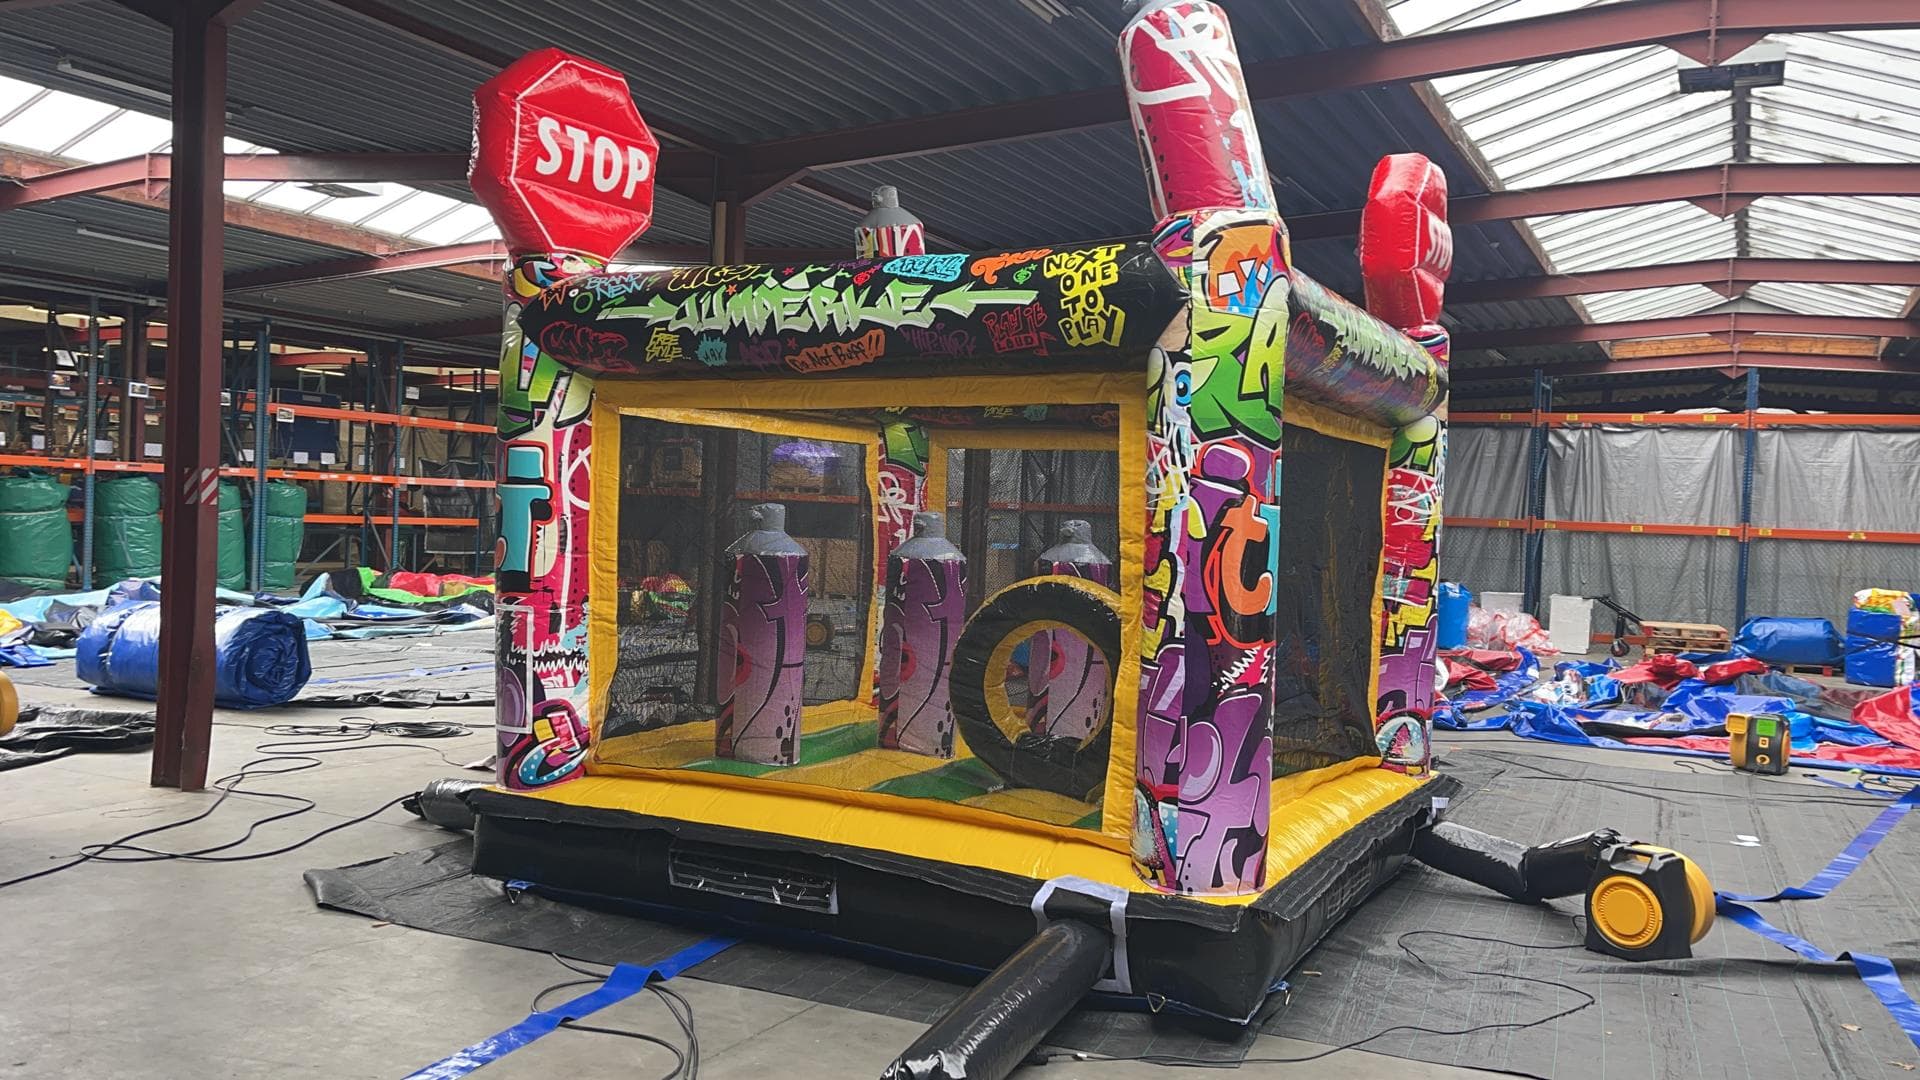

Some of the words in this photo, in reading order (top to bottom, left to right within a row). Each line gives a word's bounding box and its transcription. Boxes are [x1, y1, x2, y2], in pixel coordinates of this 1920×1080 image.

[535, 116, 650, 200] STOP
[585, 273, 641, 289] BRAND
[1061, 264, 1115, 293] ONE
[1062, 288, 1101, 315] TO
[649, 327, 680, 346] FREE
[1059, 308, 1121, 344] PLAY
[996, 336, 1034, 351] LOUD
[805, 349, 837, 368] Not
